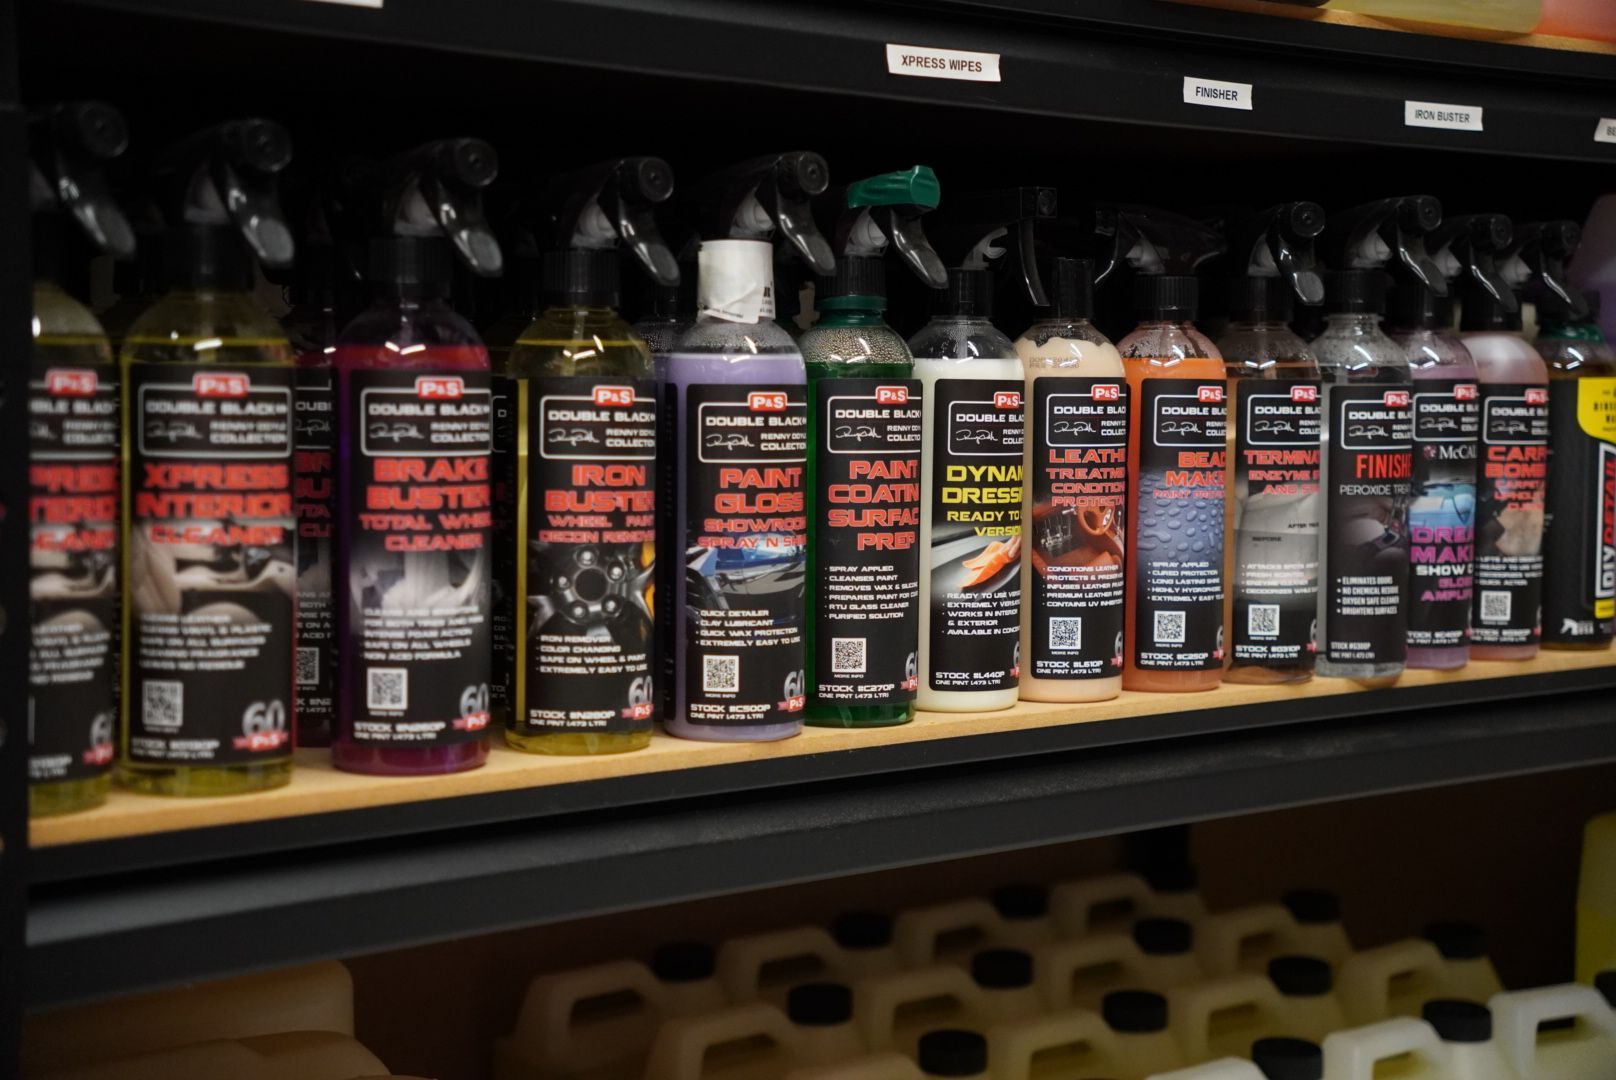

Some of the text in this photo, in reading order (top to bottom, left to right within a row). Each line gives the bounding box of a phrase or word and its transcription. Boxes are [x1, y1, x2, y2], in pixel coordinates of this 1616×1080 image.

[901, 55, 982, 72] XPRESS WIPES
[1195, 86, 1238, 101] FINISHER
[1415, 109, 1470, 123] IRON BUSTER
[421, 382, 460, 397] P&S
[880, 390, 906, 401] P&S
[1095, 388, 1118, 399] P&S
[1201, 390, 1221, 400] P&S
[1294, 389, 1315, 400] P&S
[597, 390, 631, 404] P&S
[752, 396, 784, 409] P&S
[997, 395, 1018, 407] P&S
[145, 401, 215, 415] DOUBLE
[368, 403, 436, 416] DOUBLE
[835, 409, 890, 418] DOUBLE
[1053, 406, 1104, 414] DOUBLE
[1161, 407, 1209, 415] DOUBLE
[1254, 406, 1303, 414] DOUBLE
[548, 410, 610, 422] DOUBLE
[706, 416, 764, 426] DOUBLE
[956, 413, 1006, 422] DOUBLE
[1348, 411, 1396, 420] DOUBLE
[373, 457, 488, 481] BRAKE
[572, 464, 646, 486] IRON
[849, 460, 918, 479] PAINT
[144, 463, 288, 489] XPRESS
[720, 467, 802, 488] PAINT
[1340, 484, 1391, 496] PEROXIDE
[715, 492, 804, 514] GLOSS
[358, 513, 433, 530] TOTAL
[947, 510, 1019, 521] READY TO
[698, 536, 759, 549] SPRAY
[857, 531, 916, 551] PREP
[1416, 564, 1466, 576] SHOW
[1141, 652, 1174, 660] STOCK
[935, 671, 1005, 679] STOCK #L440P
[628, 675, 653, 707] 60
[857, 684, 895, 692] #C270P
[529, 709, 566, 719] STOCK
[690, 704, 725, 712] STOCK
